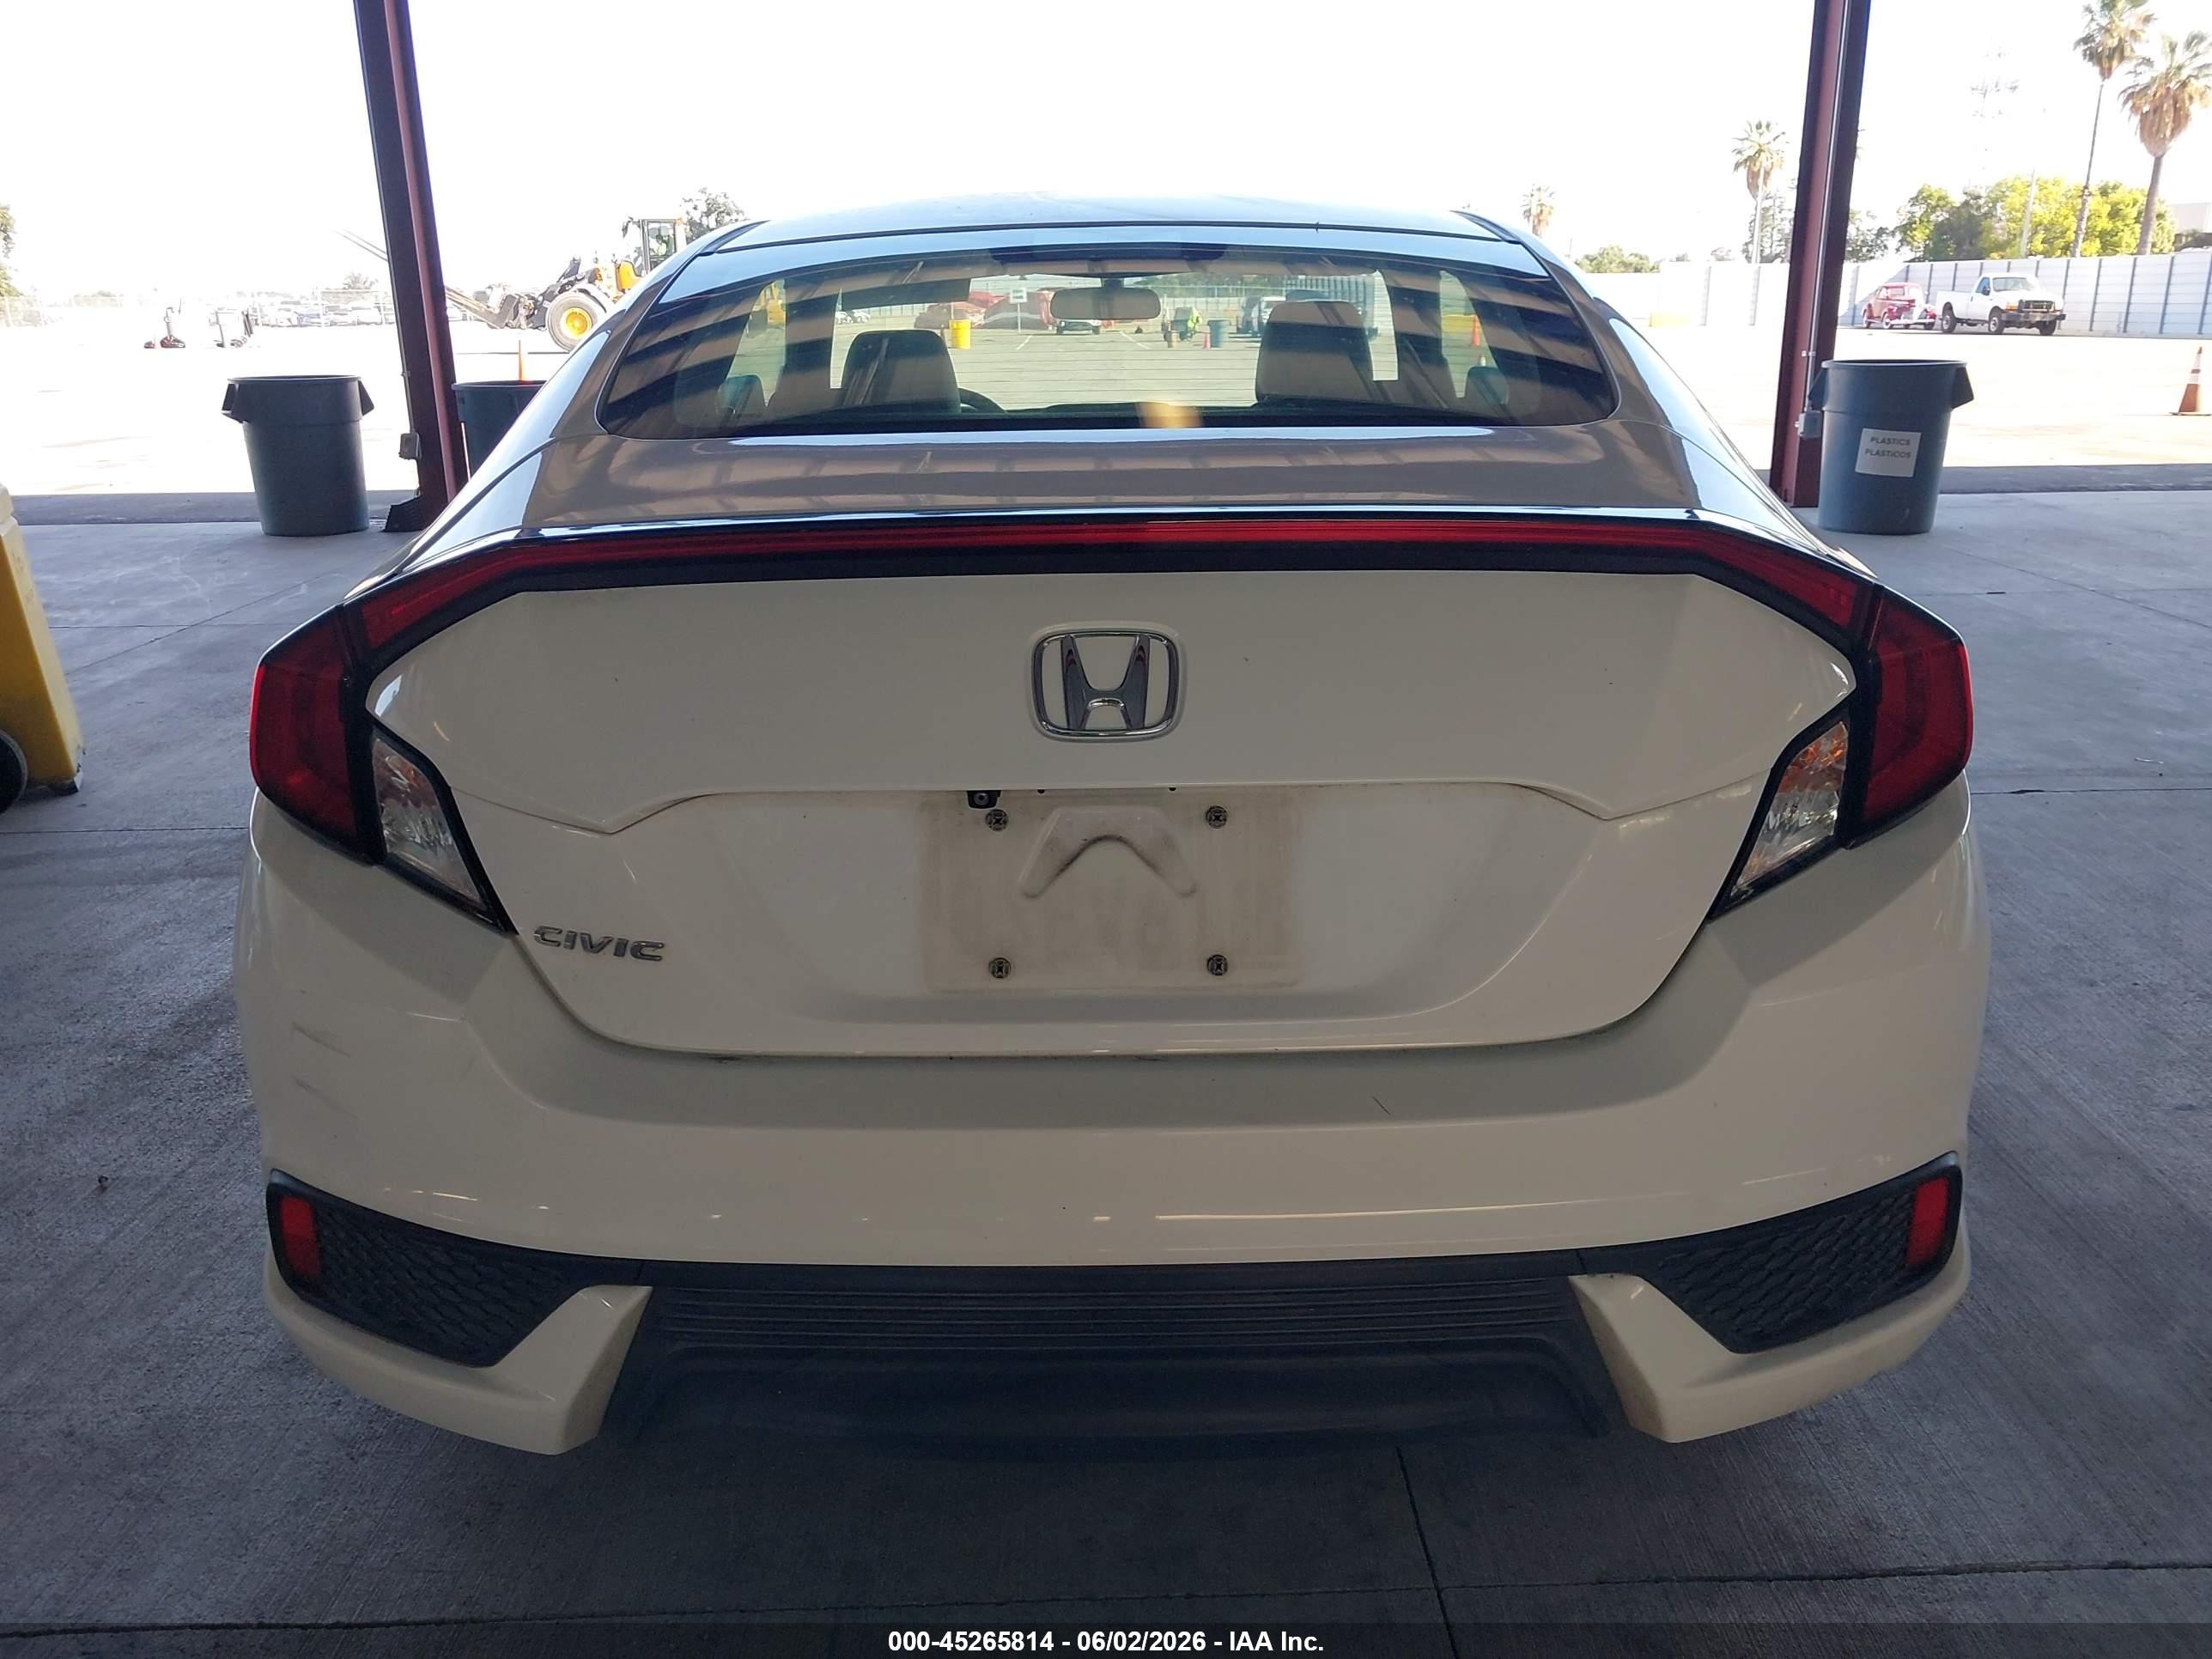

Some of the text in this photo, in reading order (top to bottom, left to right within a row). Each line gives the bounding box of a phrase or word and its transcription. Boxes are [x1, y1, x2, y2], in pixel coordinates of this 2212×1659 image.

[1870, 436, 1911, 446] PLASTICS
[1864, 447, 1911, 459] PLASTICOS
[533, 926, 665, 962] CIVIC
